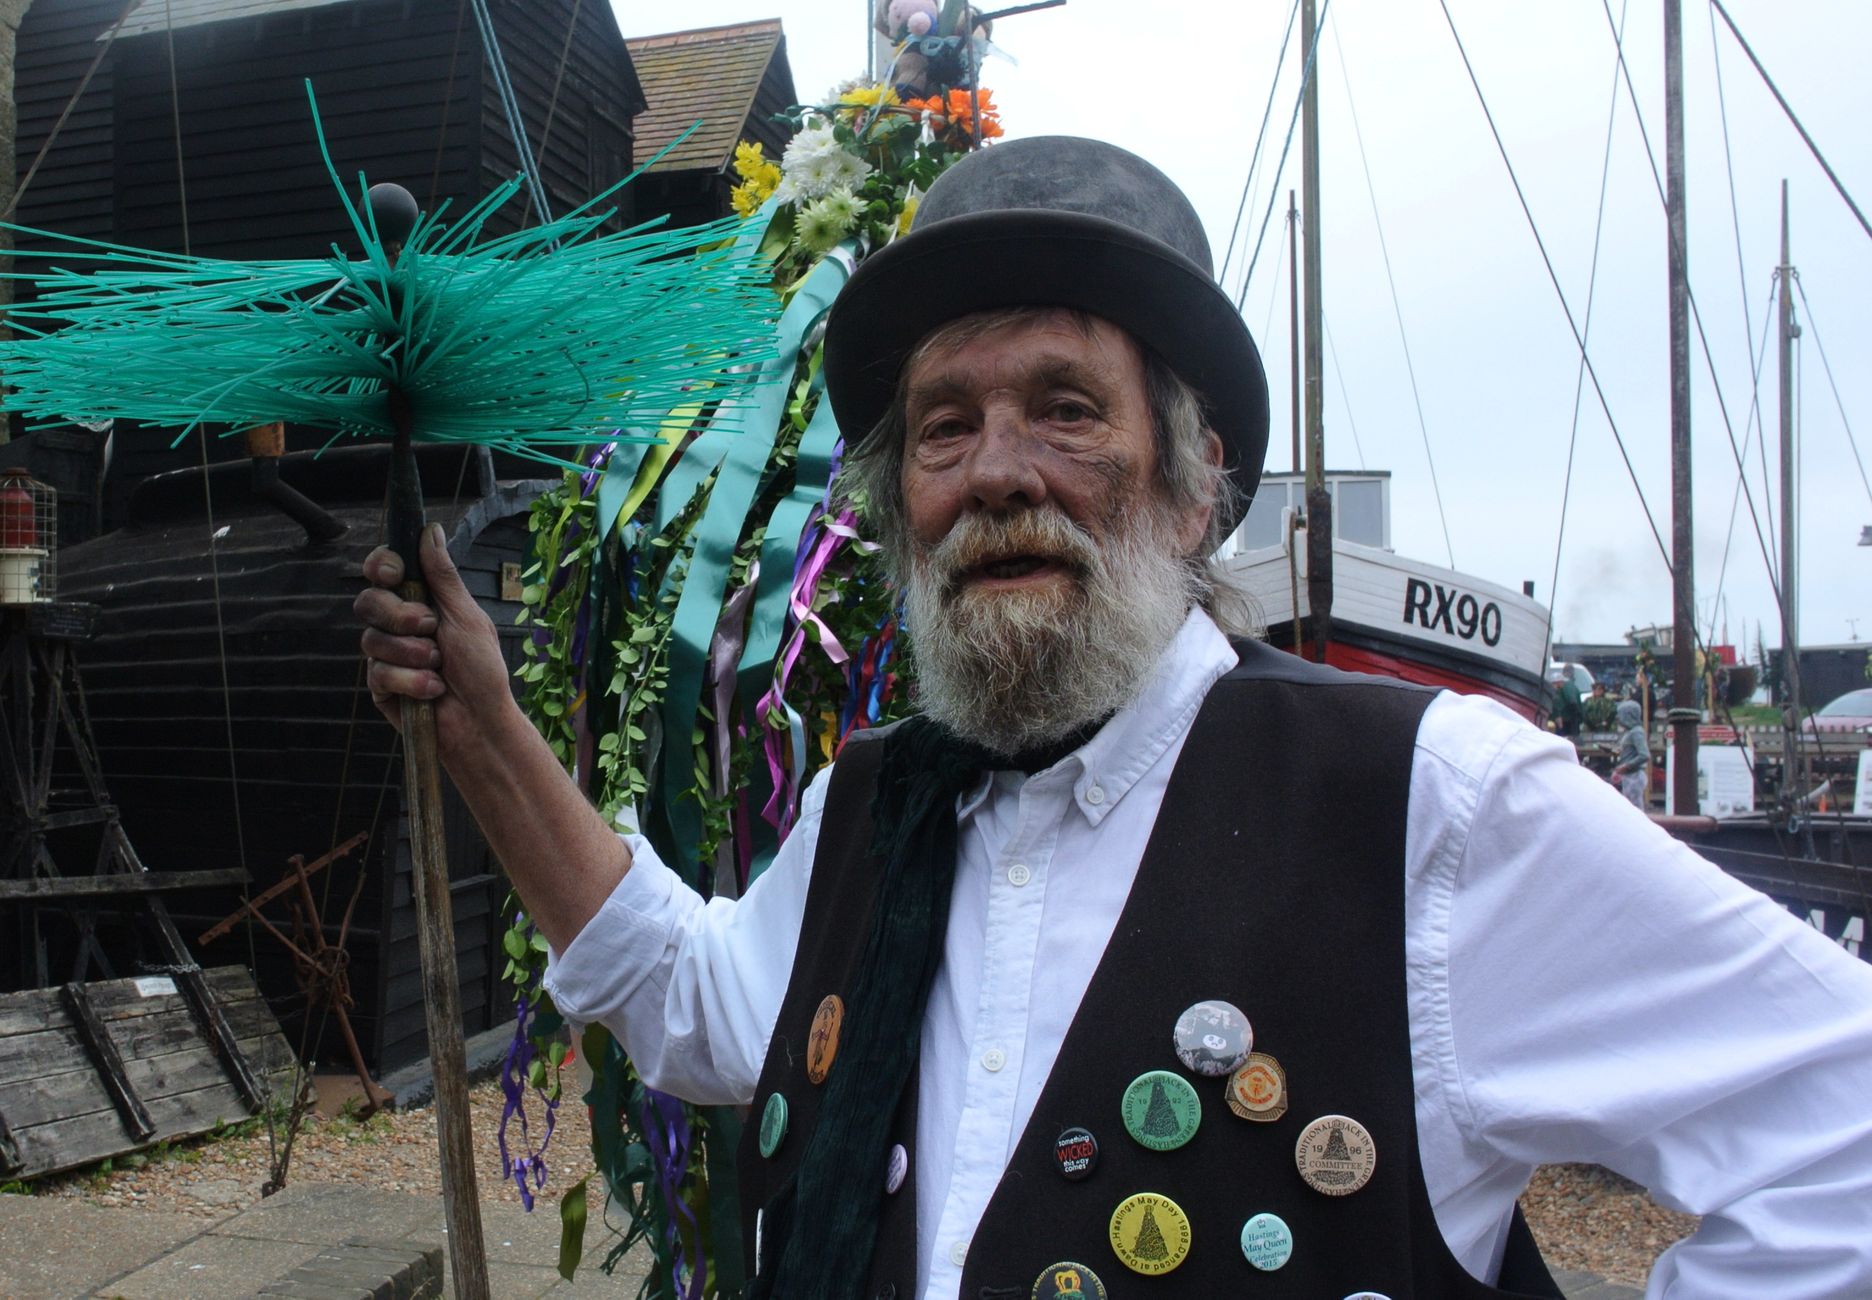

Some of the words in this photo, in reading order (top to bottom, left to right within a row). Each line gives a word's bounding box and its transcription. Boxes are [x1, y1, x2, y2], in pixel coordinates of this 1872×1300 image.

[1403, 577, 1502, 647] RX90
[1058, 1135, 1090, 1147] something
[1299, 1122, 1332, 1170] TRADITIONAL
[1341, 1121, 1362, 1138] JACK
[1360, 1135, 1370, 1147] IN
[1366, 1148, 1374, 1166] THE
[1056, 1142, 1094, 1162] WICKED
[1312, 1144, 1323, 1153] 19
[1349, 1145, 1362, 1155] 96
[1309, 1161, 1363, 1170] COMMITTEE
[1112, 1202, 1136, 1239] Hastings
[1137, 1196, 1159, 1206] May
[1161, 1200, 1179, 1217] Day
[1248, 1230, 1280, 1241] Hastings
[1244, 1244, 1263, 1253] May
[1263, 1239, 1287, 1251] Queen
